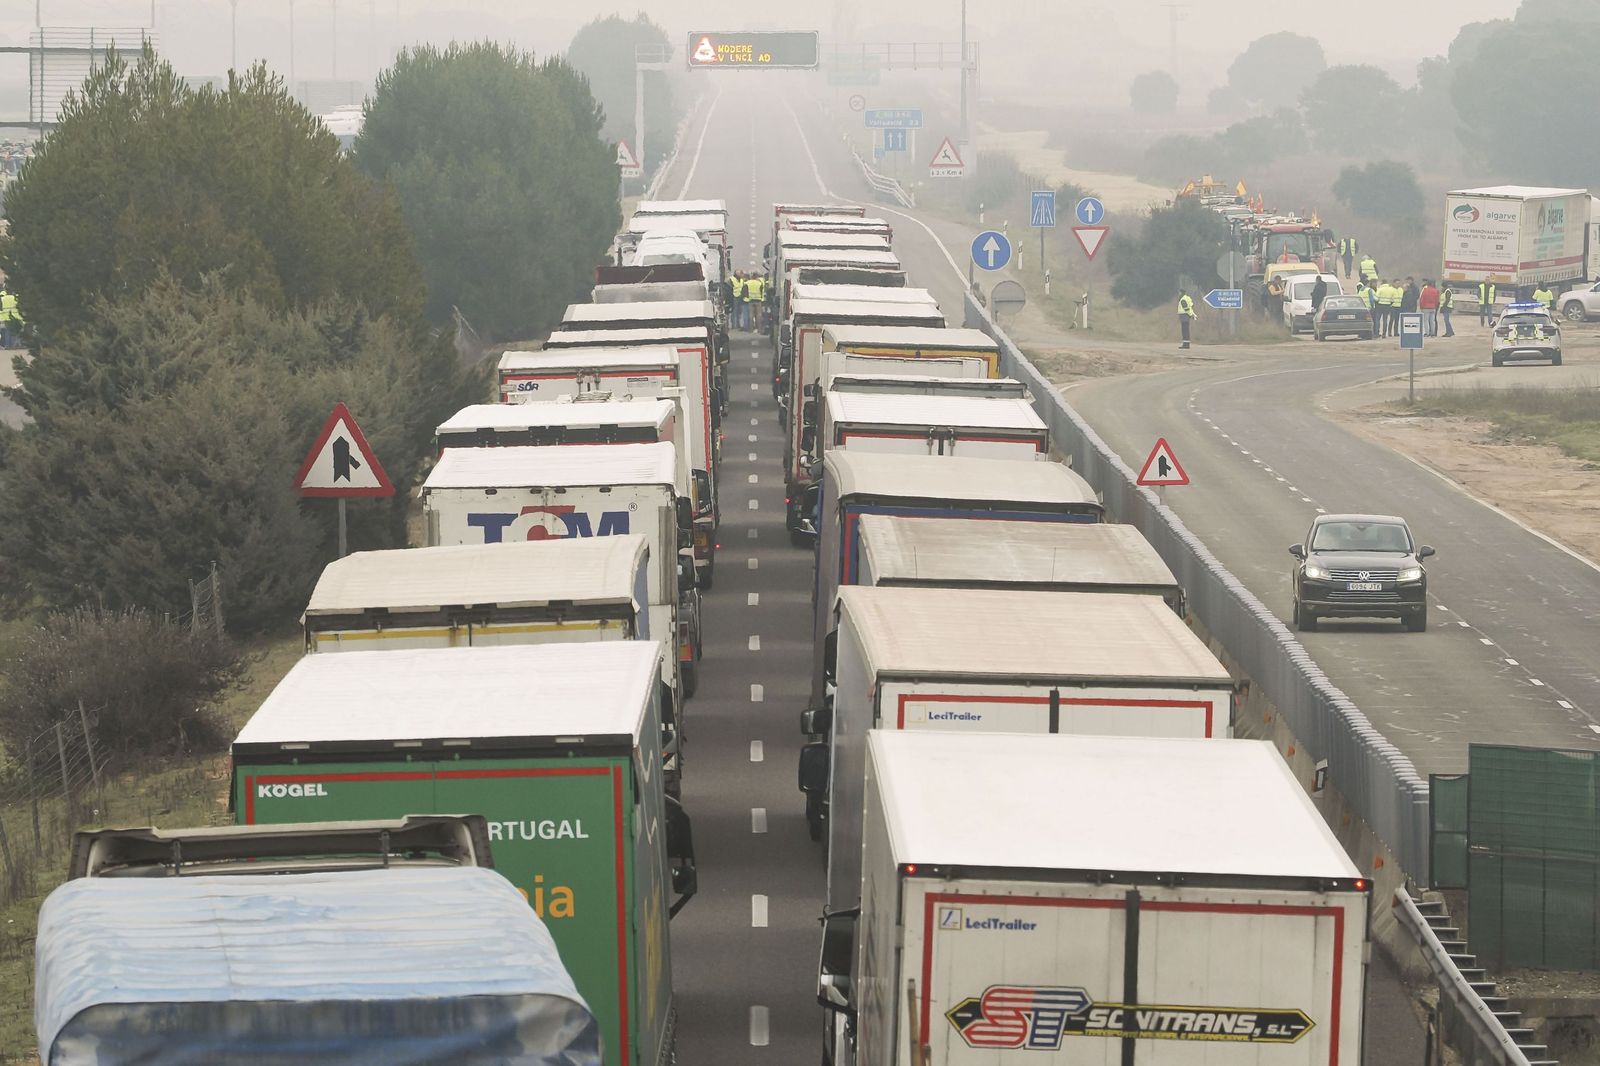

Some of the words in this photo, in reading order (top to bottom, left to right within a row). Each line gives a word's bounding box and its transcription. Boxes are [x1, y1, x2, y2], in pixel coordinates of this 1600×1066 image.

[1486, 211, 1516, 221] algarve
[928, 711, 982, 721] LeciTrailer
[258, 783, 328, 798] KÖGEL
[965, 917, 1037, 931] LeciTrailer
